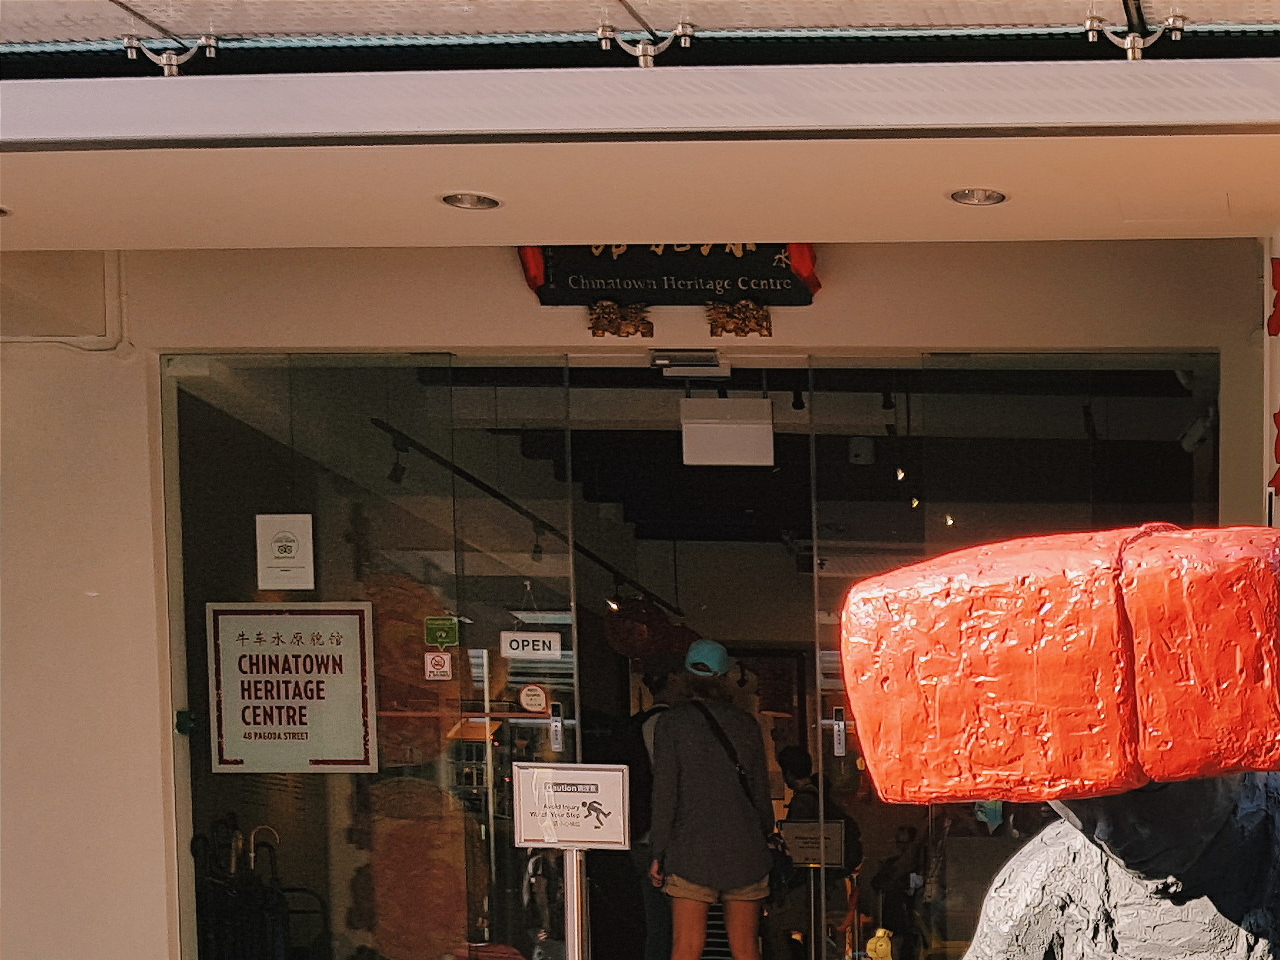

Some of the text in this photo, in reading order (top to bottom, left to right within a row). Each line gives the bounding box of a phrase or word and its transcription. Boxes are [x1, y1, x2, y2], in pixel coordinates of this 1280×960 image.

[568, 275, 792, 295] Chinatown Heritage Centre
[509, 639, 552, 651] OPEN
[238, 654, 343, 675] CHINATOWN
[241, 680, 325, 700] HERITAGE
[241, 706, 307, 726] CENTRE
[284, 732, 308, 740] STREET
